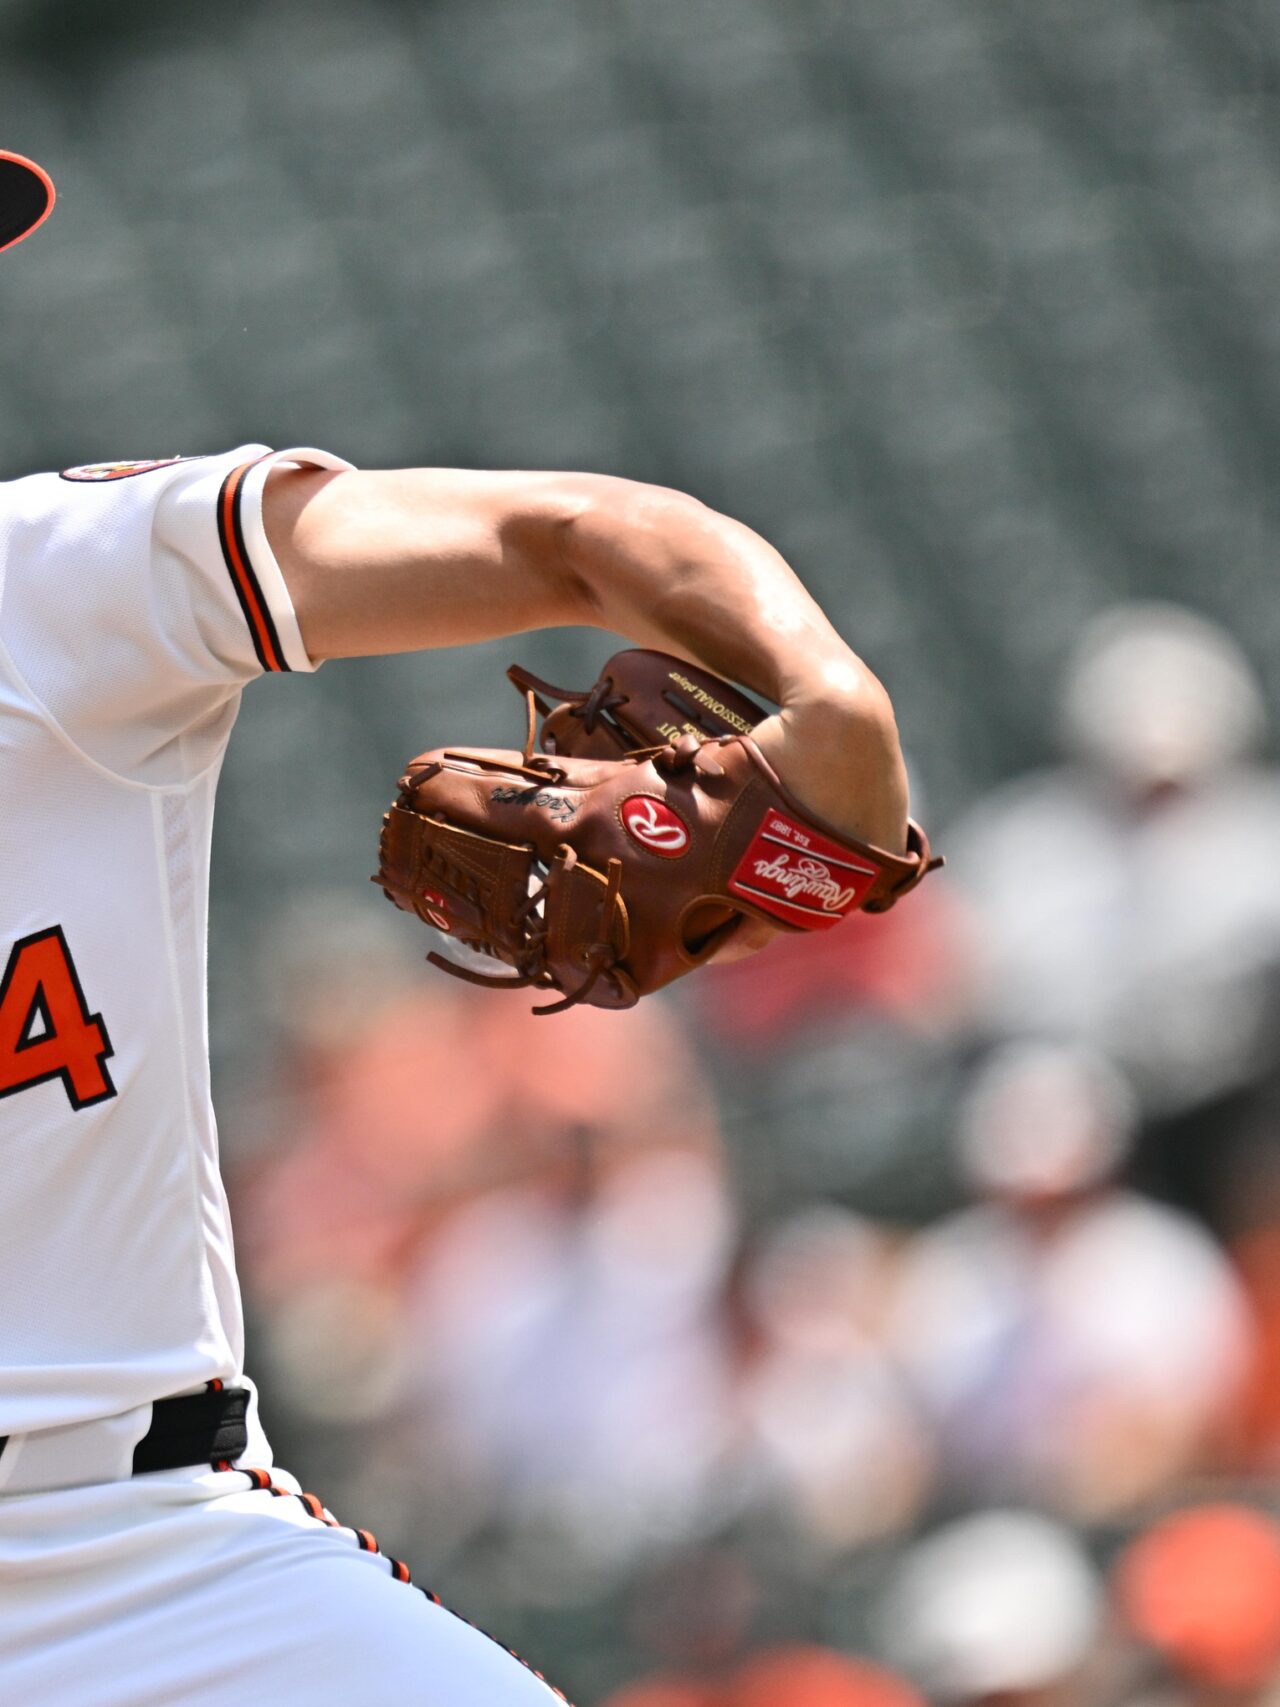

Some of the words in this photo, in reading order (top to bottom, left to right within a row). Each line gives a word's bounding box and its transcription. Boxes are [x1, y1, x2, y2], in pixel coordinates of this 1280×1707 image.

[692, 688, 754, 736] OFESSIONAL
[793, 829, 811, 847] Est.
[753, 853, 856, 911] Rawlings
